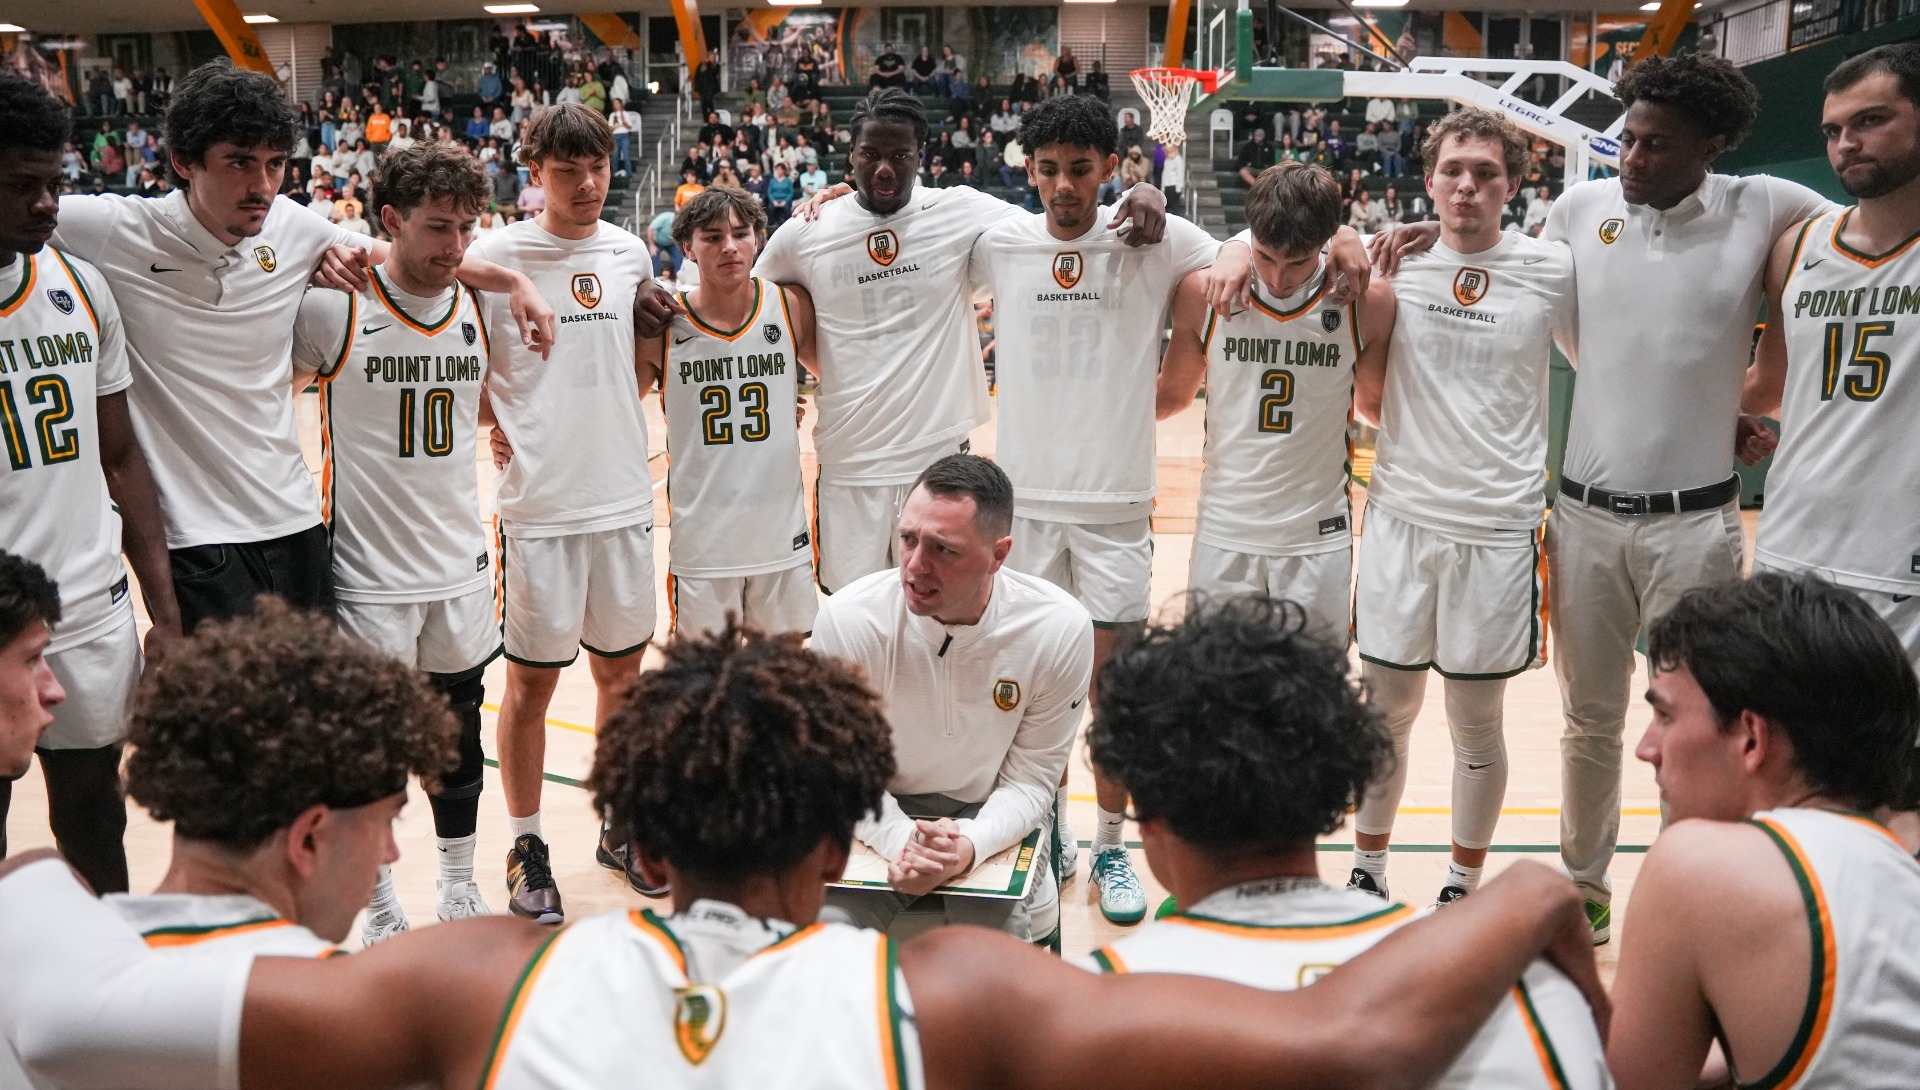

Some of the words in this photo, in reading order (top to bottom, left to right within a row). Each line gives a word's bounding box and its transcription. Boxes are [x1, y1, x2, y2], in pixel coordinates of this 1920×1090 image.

[1499, 99, 1554, 126] LEGACY
[857, 263, 921, 284] BASKETBALL
[1036, 291, 1100, 302] BASKETBALL
[1794, 286, 1867, 319] POINT
[560, 312, 619, 324] BASKETBALL
[1427, 303, 1497, 324] BASKETBALL
[20, 331, 93, 370] LOMA
[1222, 337, 1281, 361] POINT
[1284, 340, 1341, 367] LOMA
[1820, 320, 1896, 403] 15
[363, 356, 431, 383] POINT
[435, 355, 481, 382] LOMA
[679, 356, 733, 385] POINT
[737, 352, 786, 379] LOMA
[699, 381, 771, 446] 23
[1258, 369, 1295, 434] 2
[0, 373, 80, 472] 12
[399, 387, 455, 458] 10
